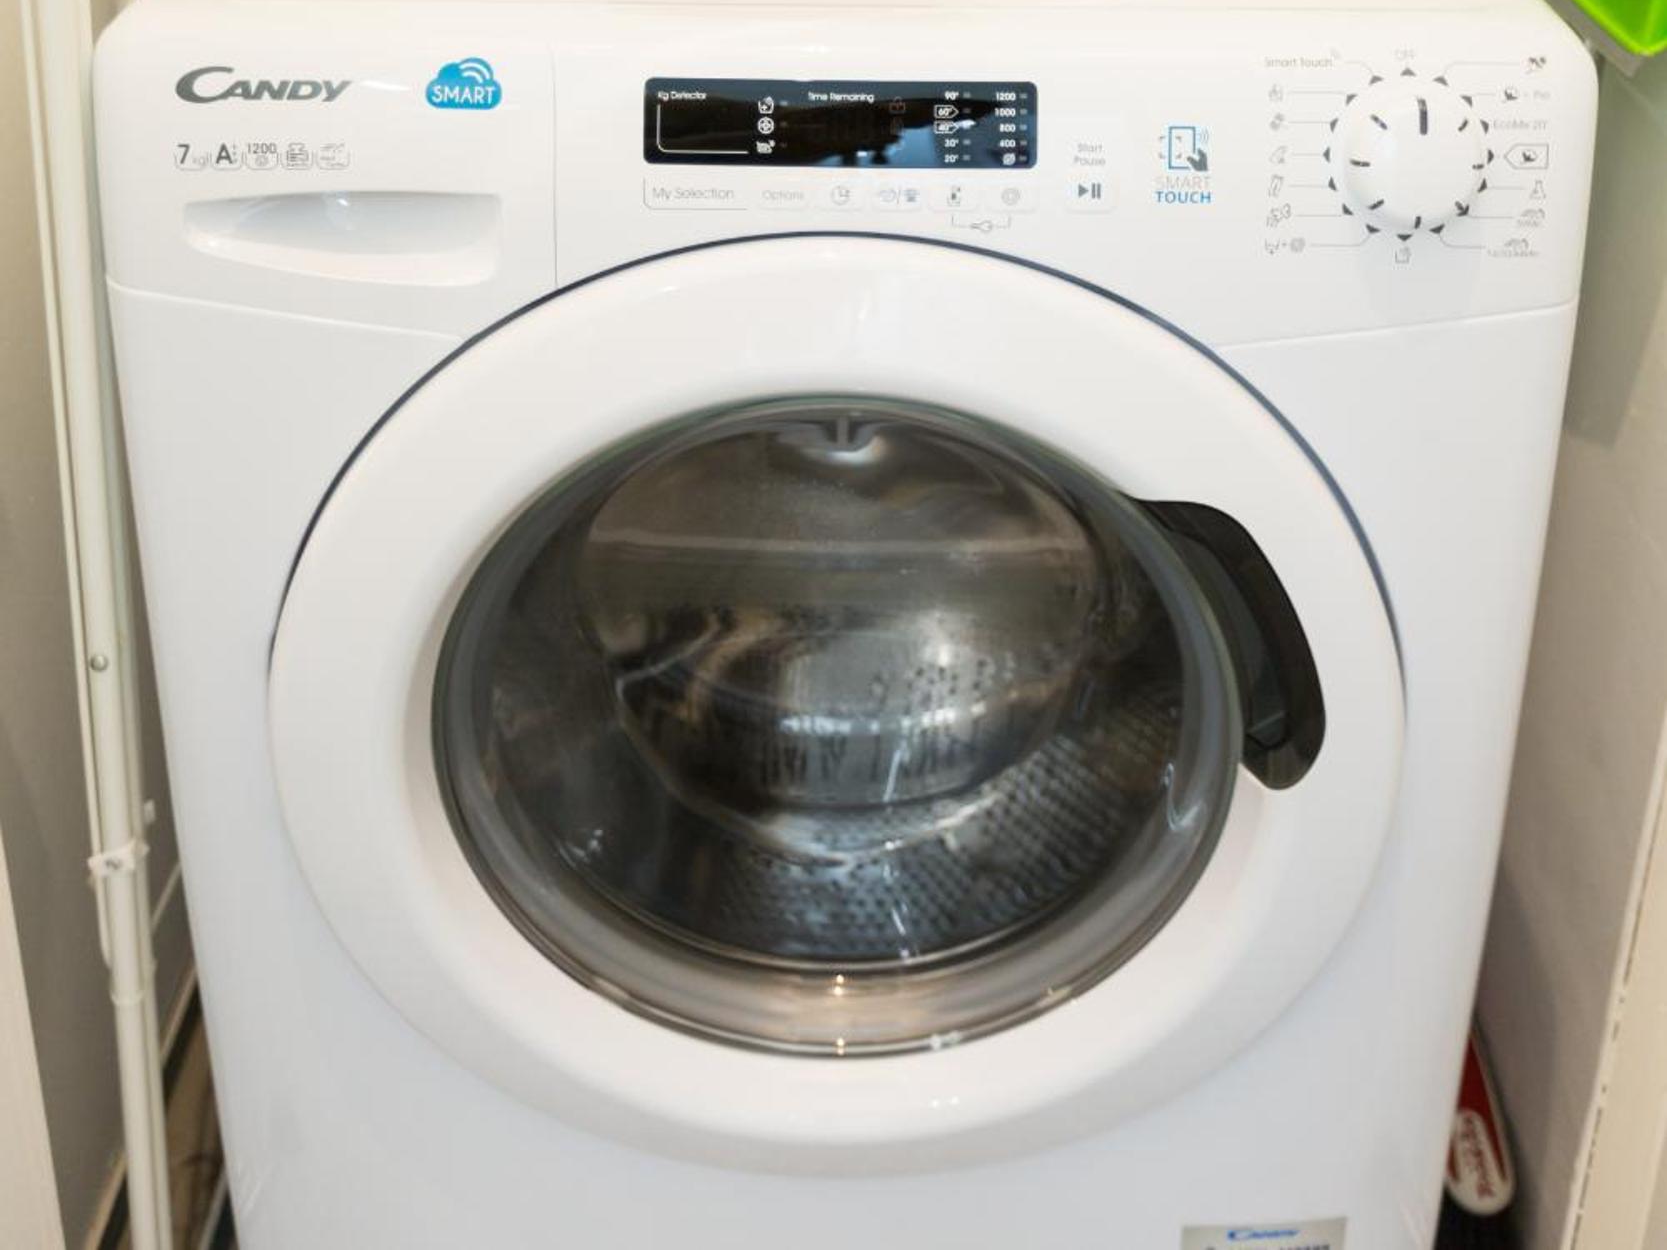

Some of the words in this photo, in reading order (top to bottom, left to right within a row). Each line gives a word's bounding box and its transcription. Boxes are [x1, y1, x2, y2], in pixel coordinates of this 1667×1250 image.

[175, 66, 353, 103] CANDY
[431, 85, 495, 104] SMART
[808, 91, 828, 101] Time
[830, 91, 875, 104] Remaining
[996, 92, 1016, 101] 1200
[994, 107, 1016, 117] 1000
[1000, 123, 1016, 133] 800
[247, 142, 277, 155] 1200
[1000, 139, 1016, 148] 400
[177, 143, 190, 165] 7
[1074, 156, 1106, 167] Pause
[1156, 176, 1212, 189] SMART
[651, 187, 671, 201] My
[674, 187, 735, 199] Selection
[761, 189, 805, 202] Options
[1156, 190, 1212, 204] TOUCH
